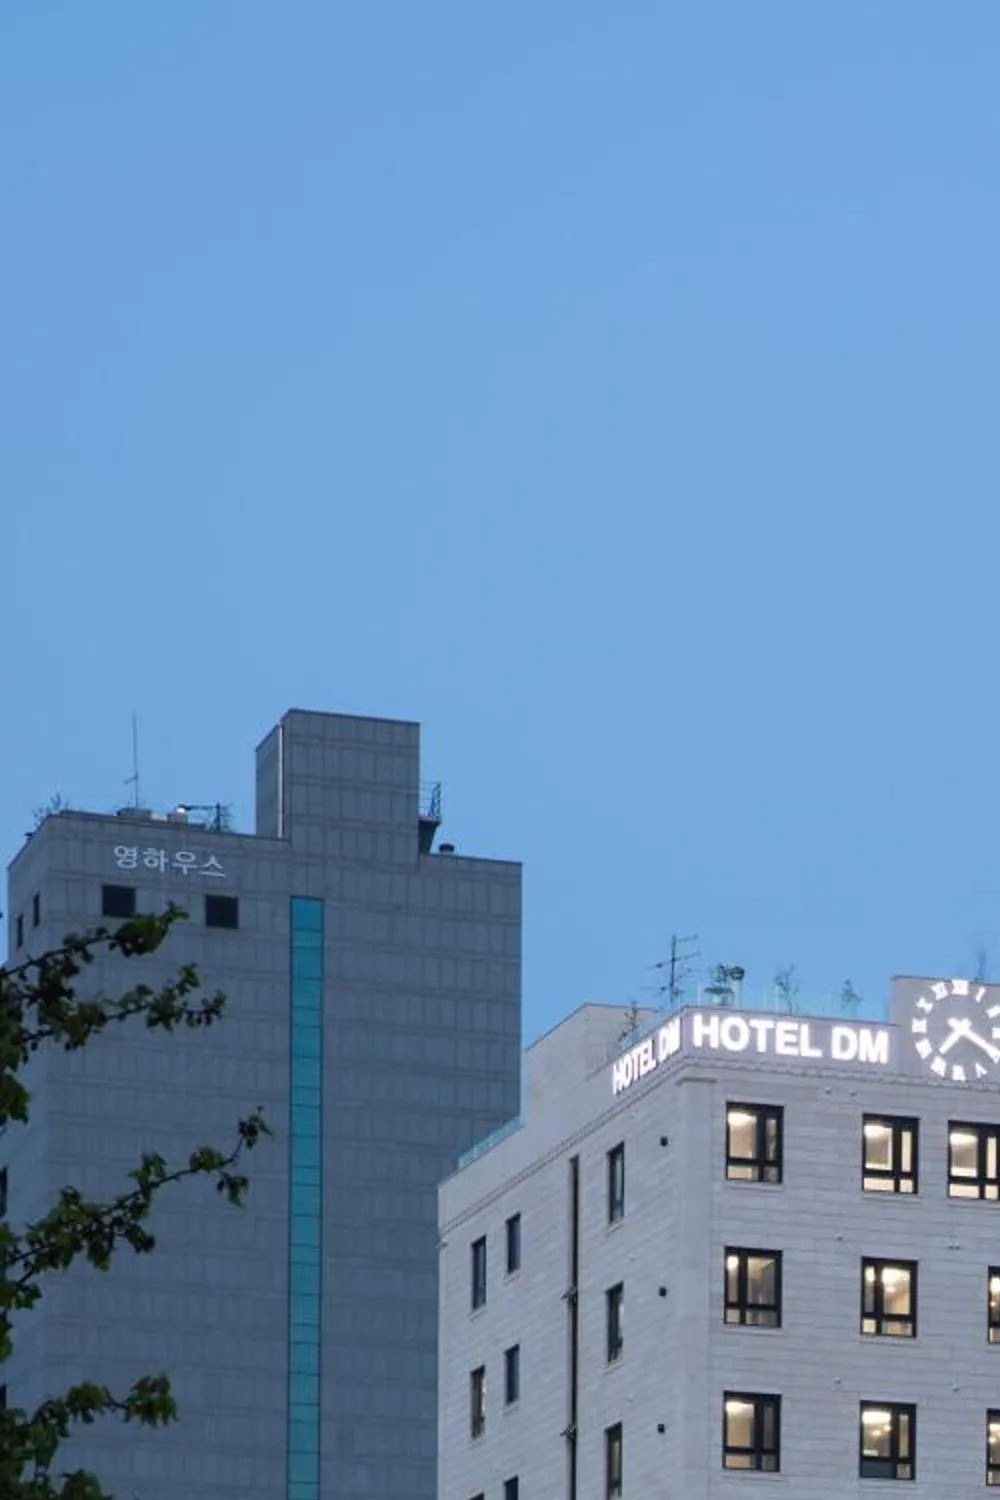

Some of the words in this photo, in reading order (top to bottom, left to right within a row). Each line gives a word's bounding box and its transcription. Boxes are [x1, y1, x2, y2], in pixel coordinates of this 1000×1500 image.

[113, 845, 227, 878] 영하우스
[693, 1013, 822, 1058] HOTEL
[830, 1025, 890, 1064] DM
[613, 1039, 657, 1095] HOTEL
